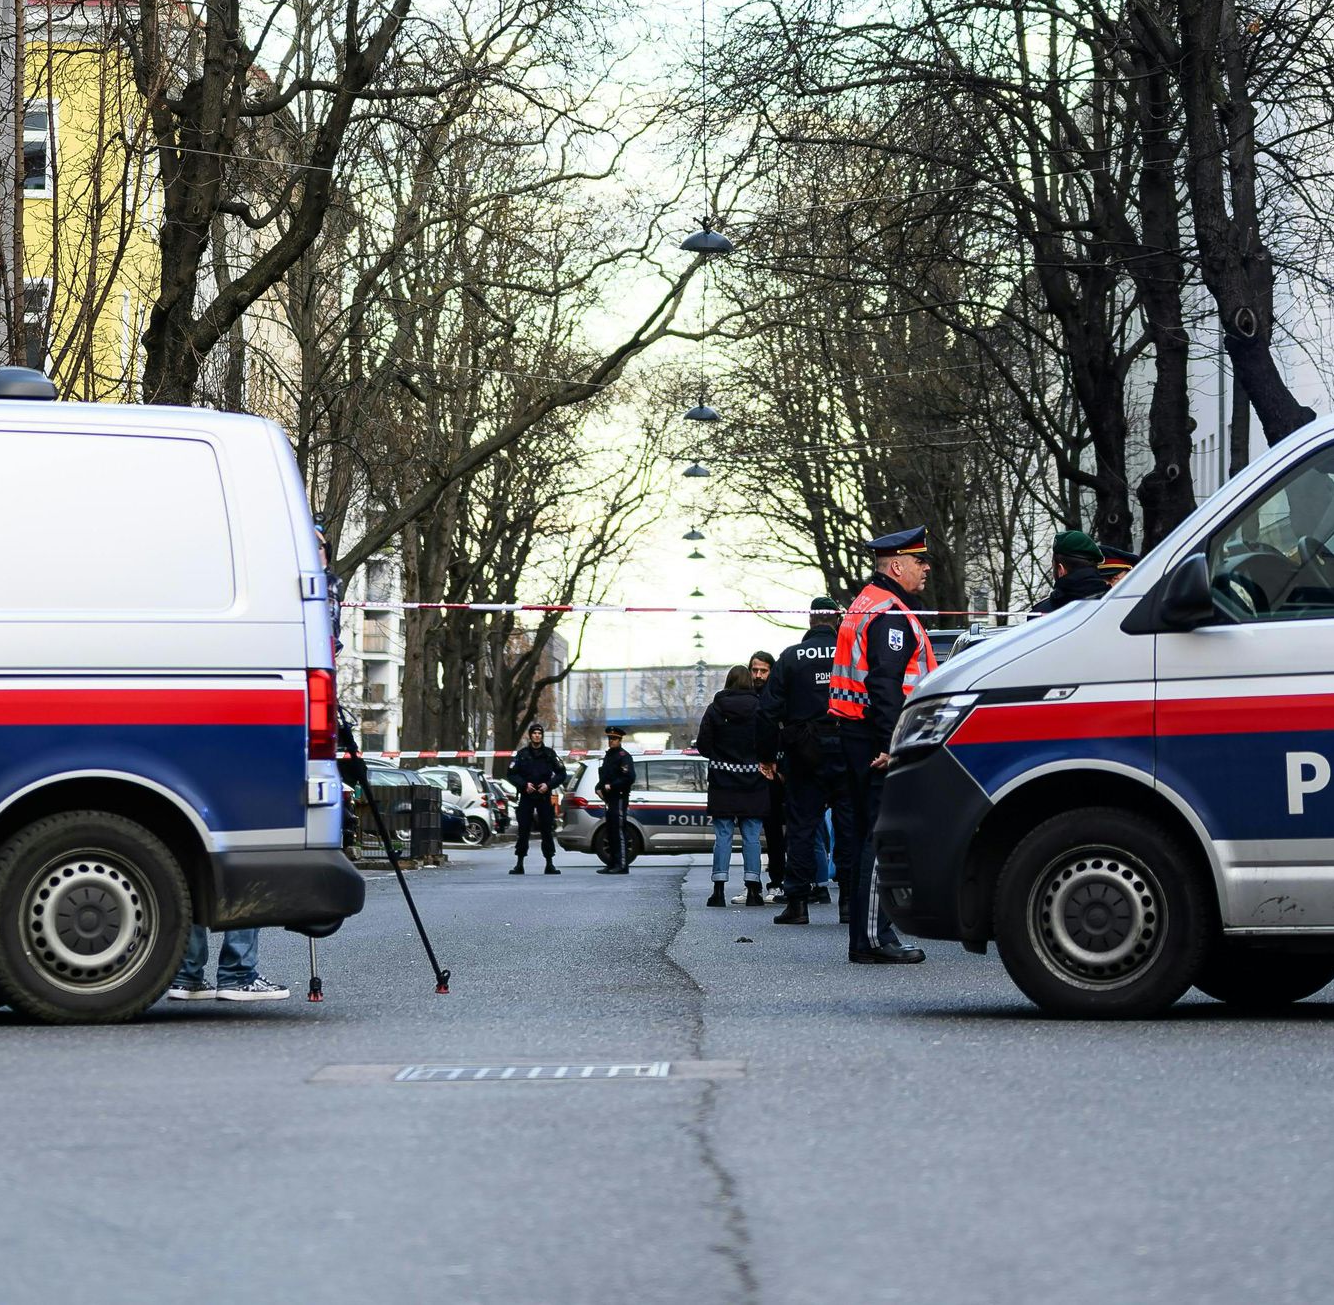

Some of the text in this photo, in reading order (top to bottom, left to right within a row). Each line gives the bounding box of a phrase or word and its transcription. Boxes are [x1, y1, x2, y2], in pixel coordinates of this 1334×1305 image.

[796, 646, 838, 661] POLIZ
[815, 672, 831, 681] PDH
[668, 814, 714, 826] POLIZ
